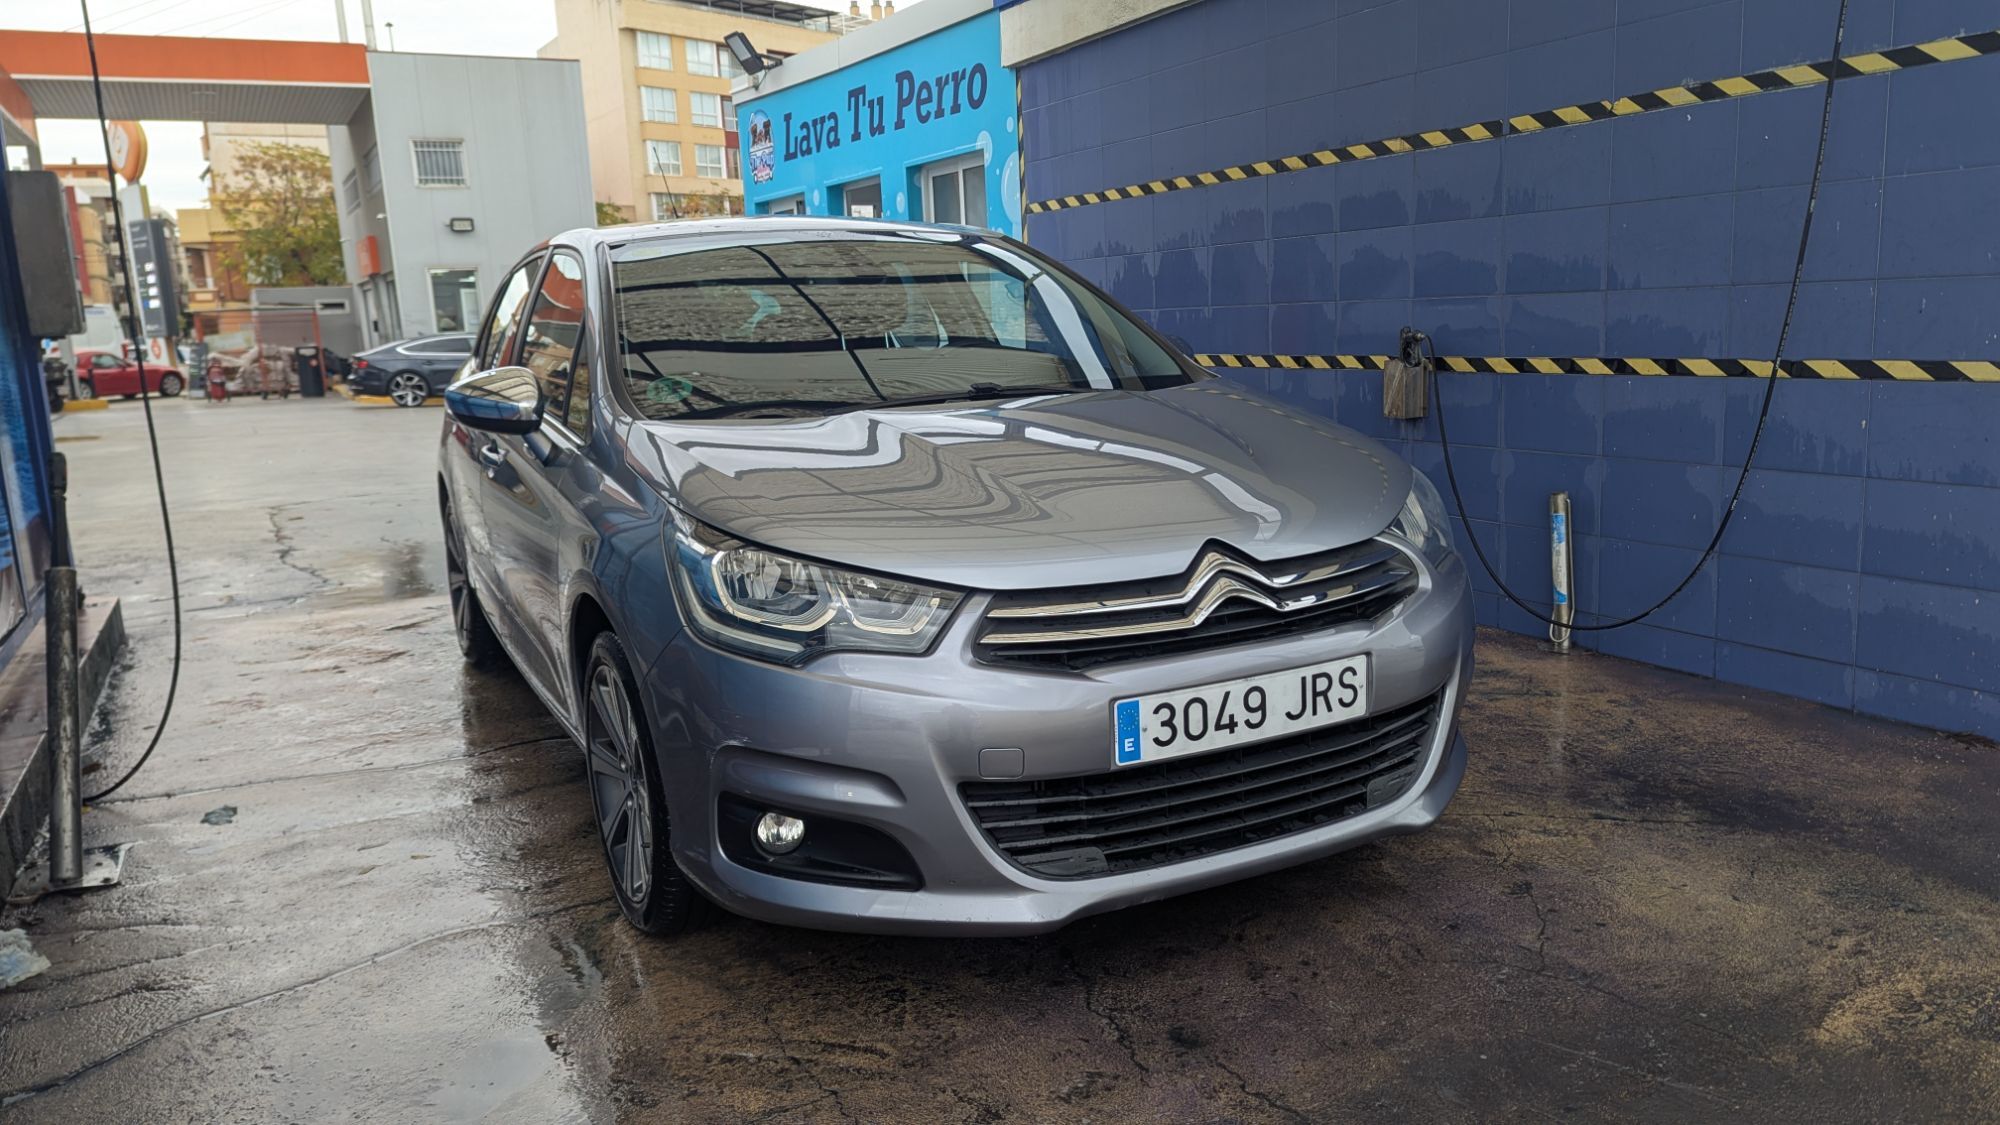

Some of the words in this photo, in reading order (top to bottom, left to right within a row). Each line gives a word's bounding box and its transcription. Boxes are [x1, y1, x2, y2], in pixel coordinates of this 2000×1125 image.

[784, 111, 840, 162] Lava
[847, 84, 885, 143] Tu
[894, 62, 988, 131] Perro
[1124, 737, 1135, 752] E
[1152, 685, 1267, 748] 3049
[1285, 666, 1359, 721] JRS
